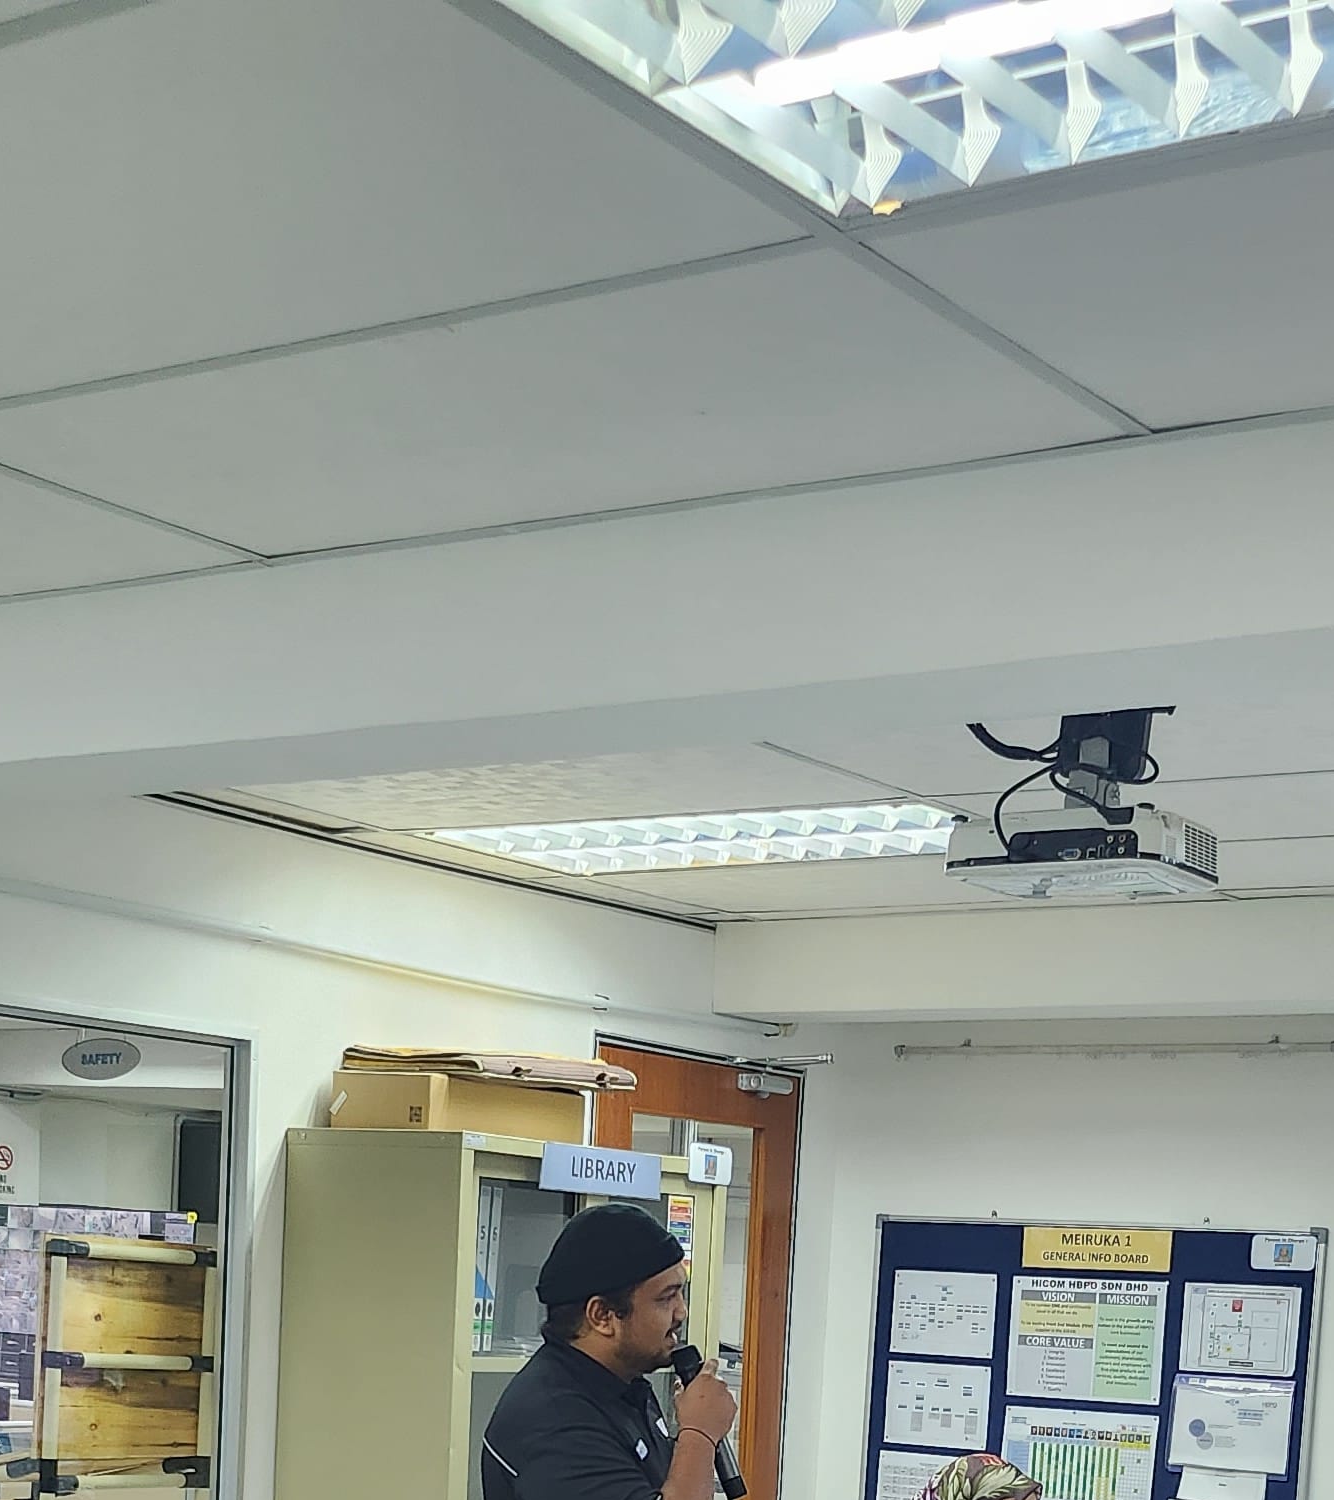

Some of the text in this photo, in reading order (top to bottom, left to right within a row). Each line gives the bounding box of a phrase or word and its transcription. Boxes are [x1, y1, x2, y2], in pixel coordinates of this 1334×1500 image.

[81, 1052, 122, 1066] SAFETY
[570, 1155, 637, 1184] LIBRARY
[1061, 1233, 1132, 1247] MEIRUKA 1
[1042, 1251, 1149, 1264] GENERAL INFO BOARD
[1031, 1279, 1149, 1292] HICOM HBPO SDN BHD
[1041, 1291, 1075, 1302] VISION
[1106, 1294, 1150, 1306] MISSION
[1025, 1336, 1086, 1349] CORE VALUE
